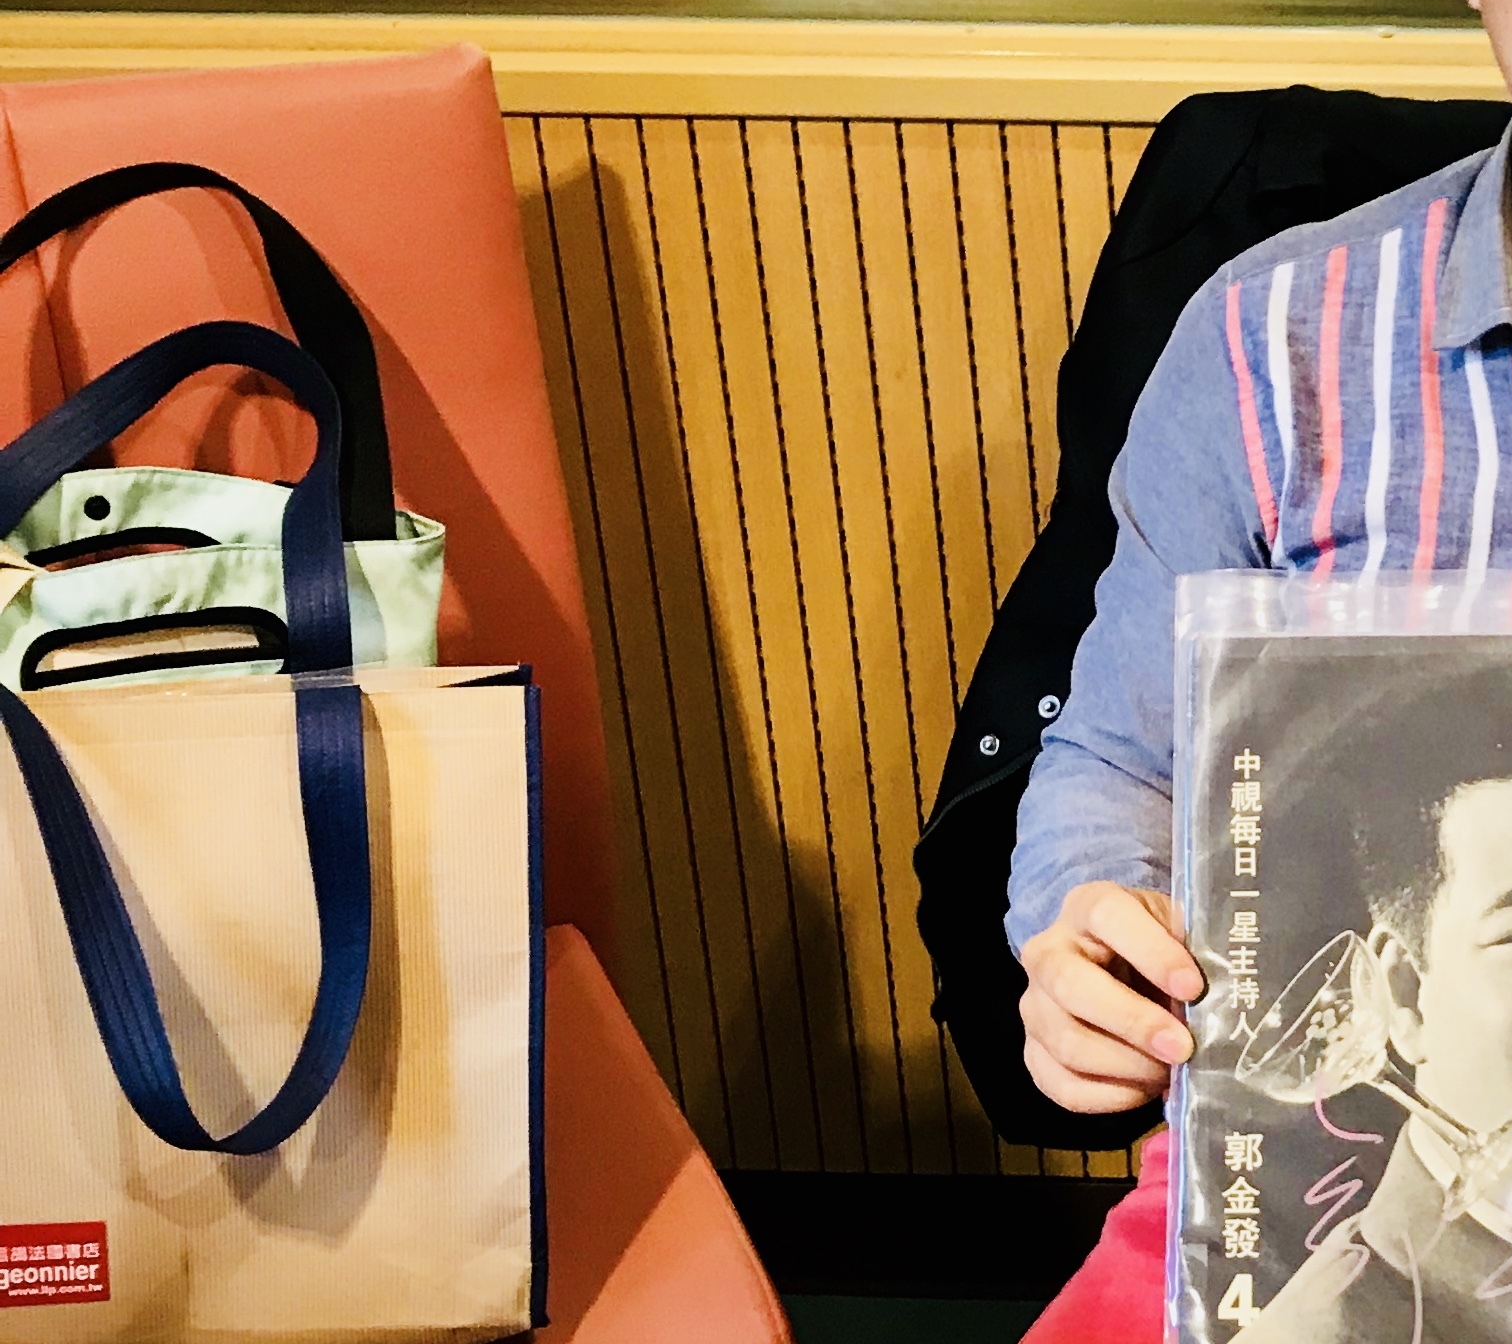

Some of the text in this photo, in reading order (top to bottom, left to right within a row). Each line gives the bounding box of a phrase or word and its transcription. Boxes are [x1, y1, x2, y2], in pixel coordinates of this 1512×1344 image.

[1229, 748, 1262, 1041] 中視每日一星主持人
[1222, 1132, 1264, 1258] 郭金發
[1217, 1273, 1262, 1327] 4
